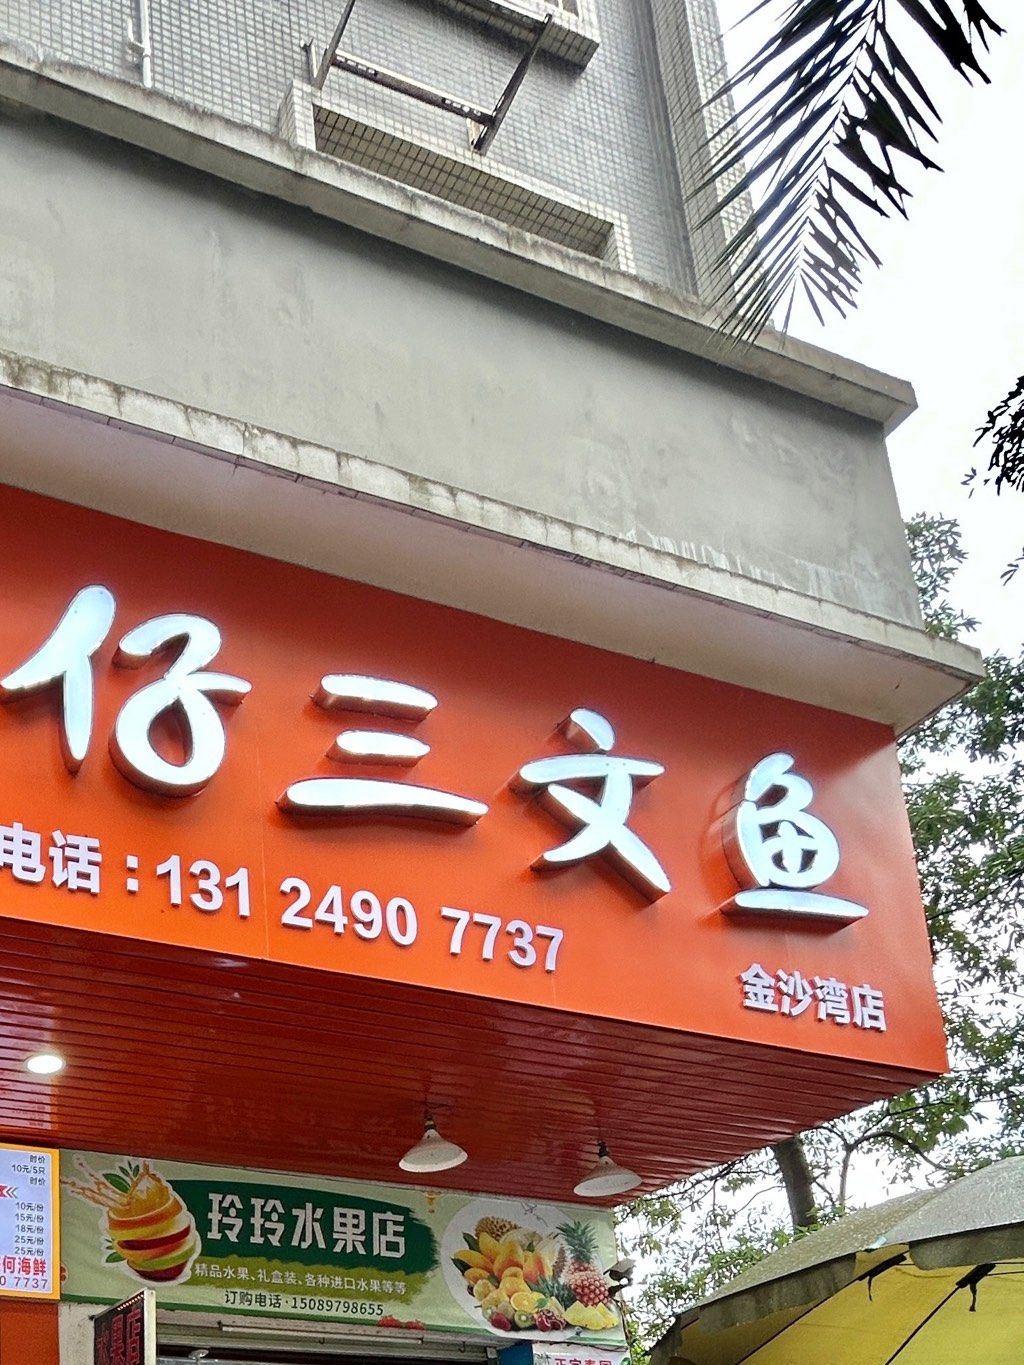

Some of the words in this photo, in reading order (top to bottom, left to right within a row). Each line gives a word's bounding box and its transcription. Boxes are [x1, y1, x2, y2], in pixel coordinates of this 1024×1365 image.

[156, 855, 252, 918] 131
[279, 877, 418, 947] 2490
[440, 906, 565, 973] 7737
[739, 963, 887, 1033] 金沙湾店
[208, 1192, 406, 1259] 玲玲水果店
[14, 1277, 47, 1288] 7737
[195, 1263, 407, 1295] 精品水果、礼盒装、各种进口水果等等
